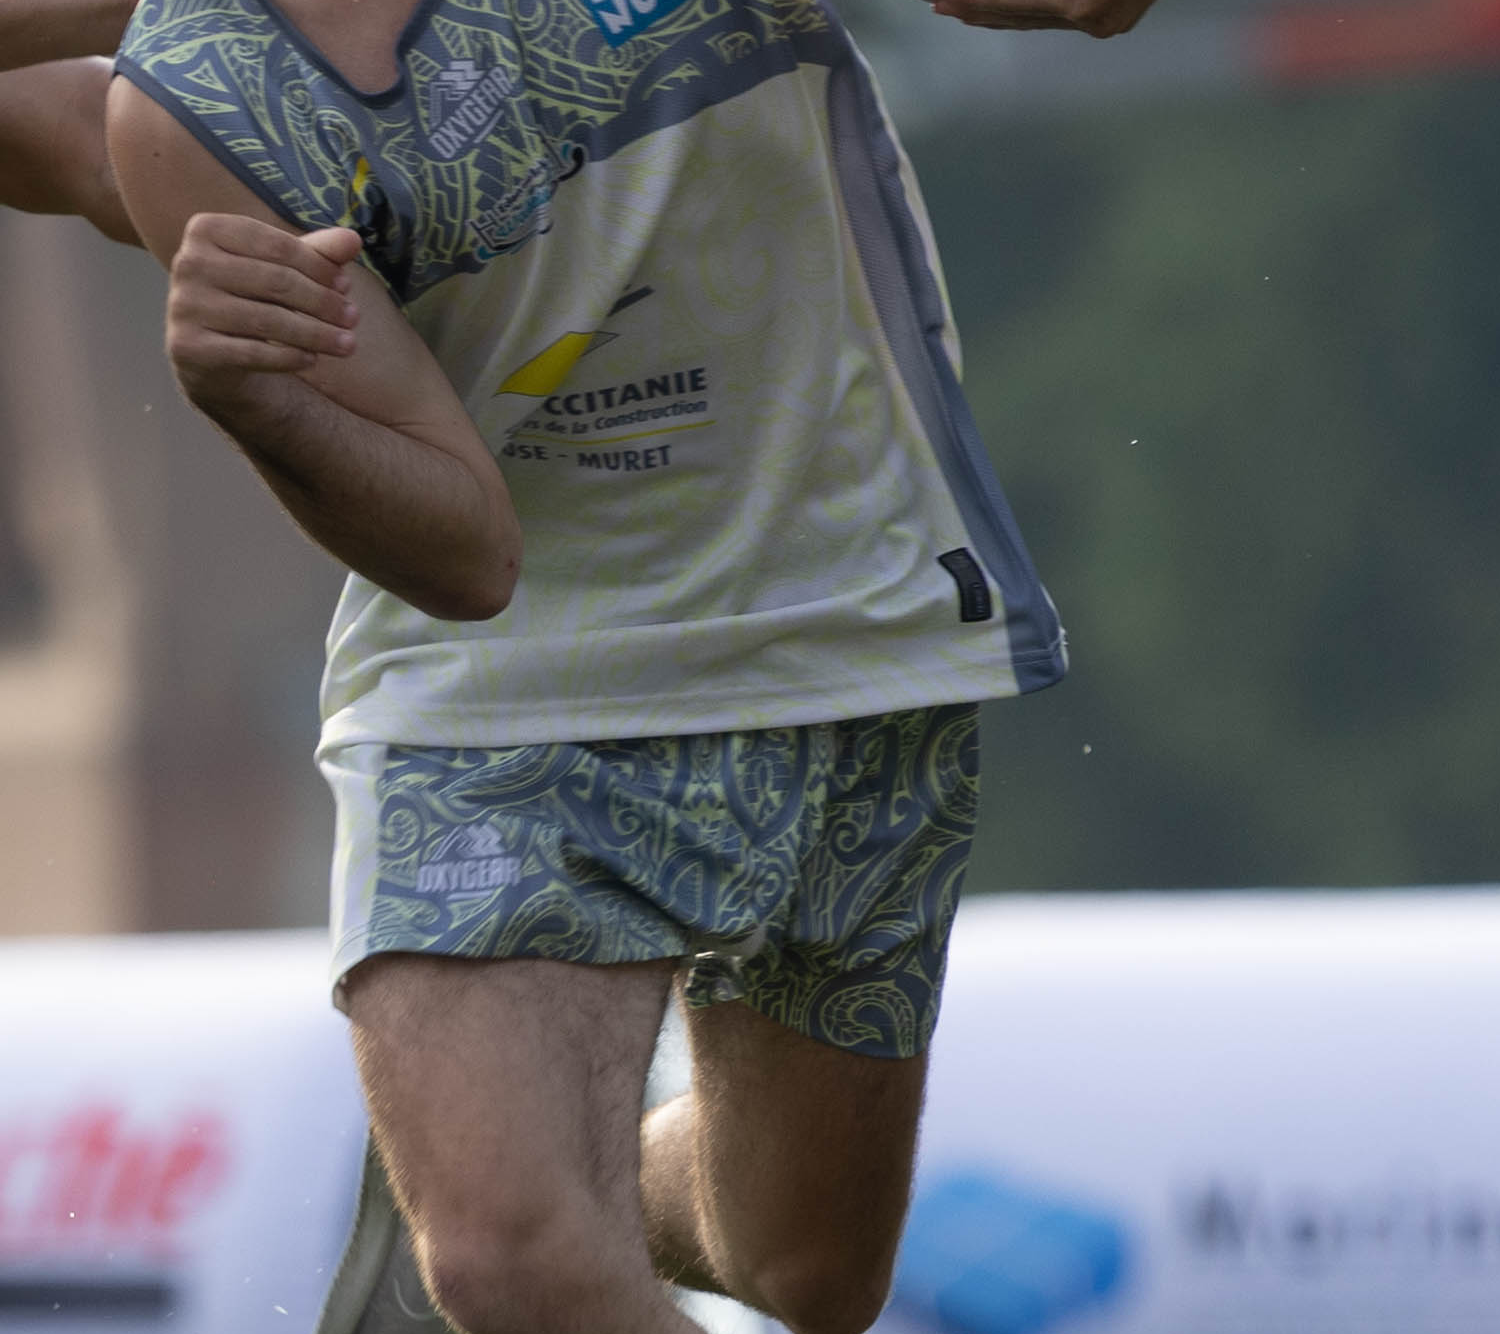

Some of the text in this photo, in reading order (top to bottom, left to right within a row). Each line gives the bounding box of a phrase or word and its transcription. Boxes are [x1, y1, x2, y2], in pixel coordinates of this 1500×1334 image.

[428, 65, 512, 158] OXYGEAR
[594, 400, 707, 431] Construction
[577, 444, 672, 471] MURET
[416, 857, 522, 893] OXYGEAR
